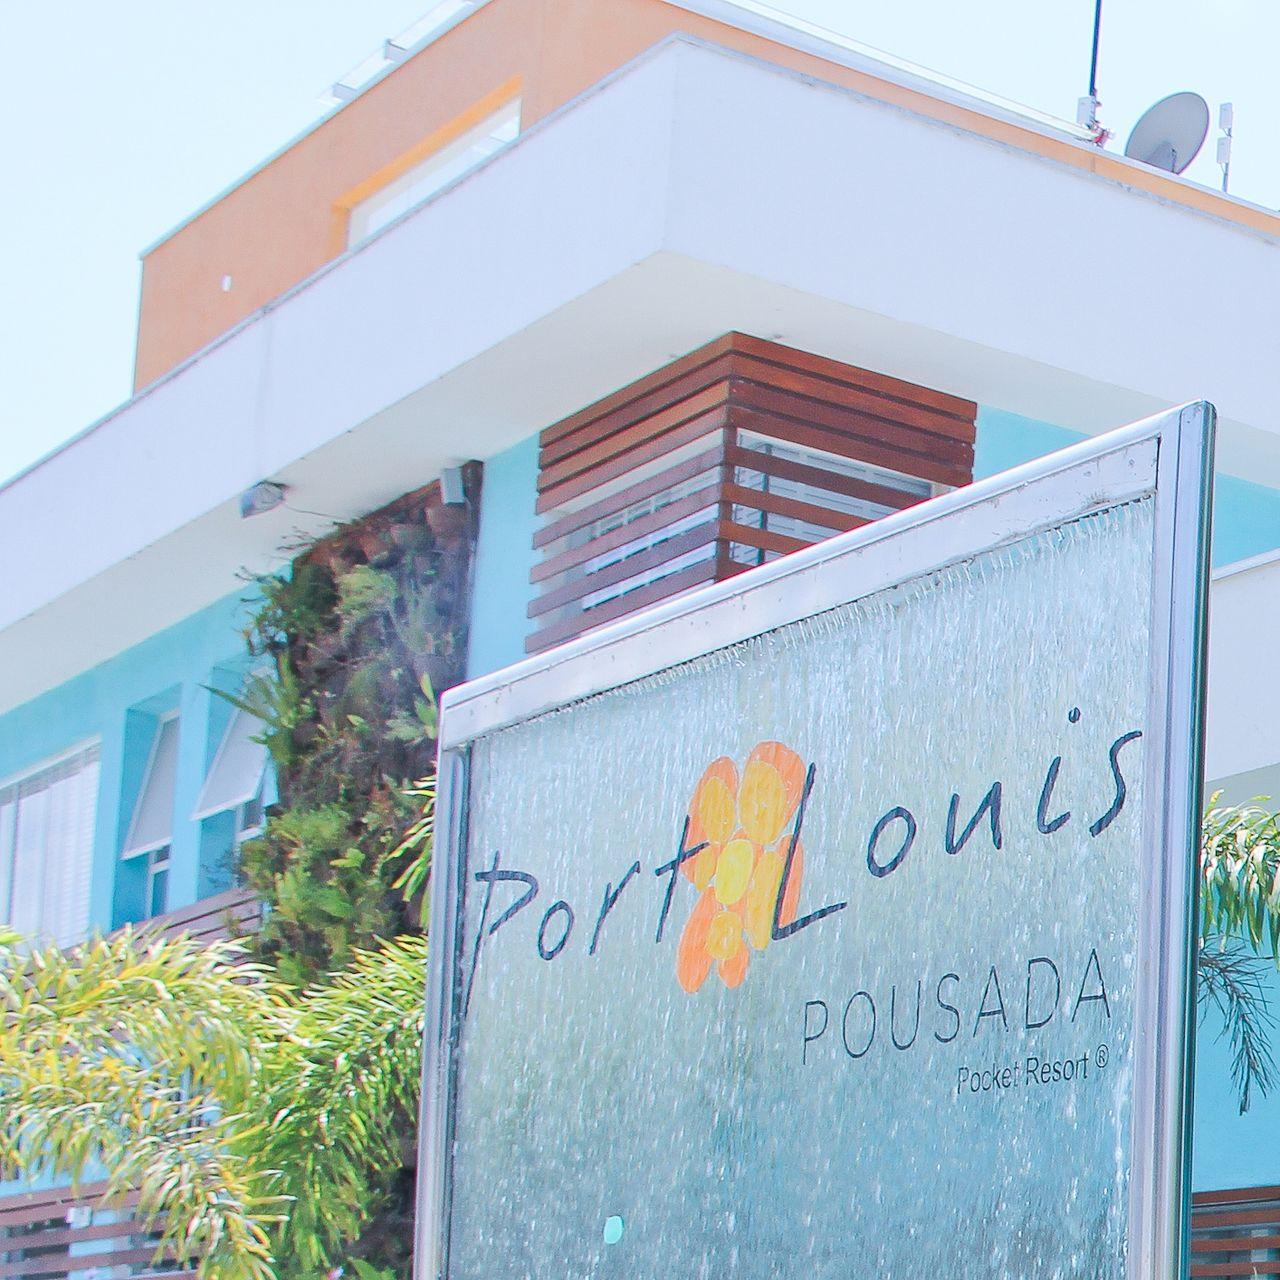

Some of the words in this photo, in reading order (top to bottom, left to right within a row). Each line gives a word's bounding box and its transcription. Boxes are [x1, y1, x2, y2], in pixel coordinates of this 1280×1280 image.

[465, 814, 711, 1020] Port
[771, 706, 1143, 942] Louis
[802, 947, 1112, 1066] POUSADA
[957, 1061, 1020, 1094] Pocket
